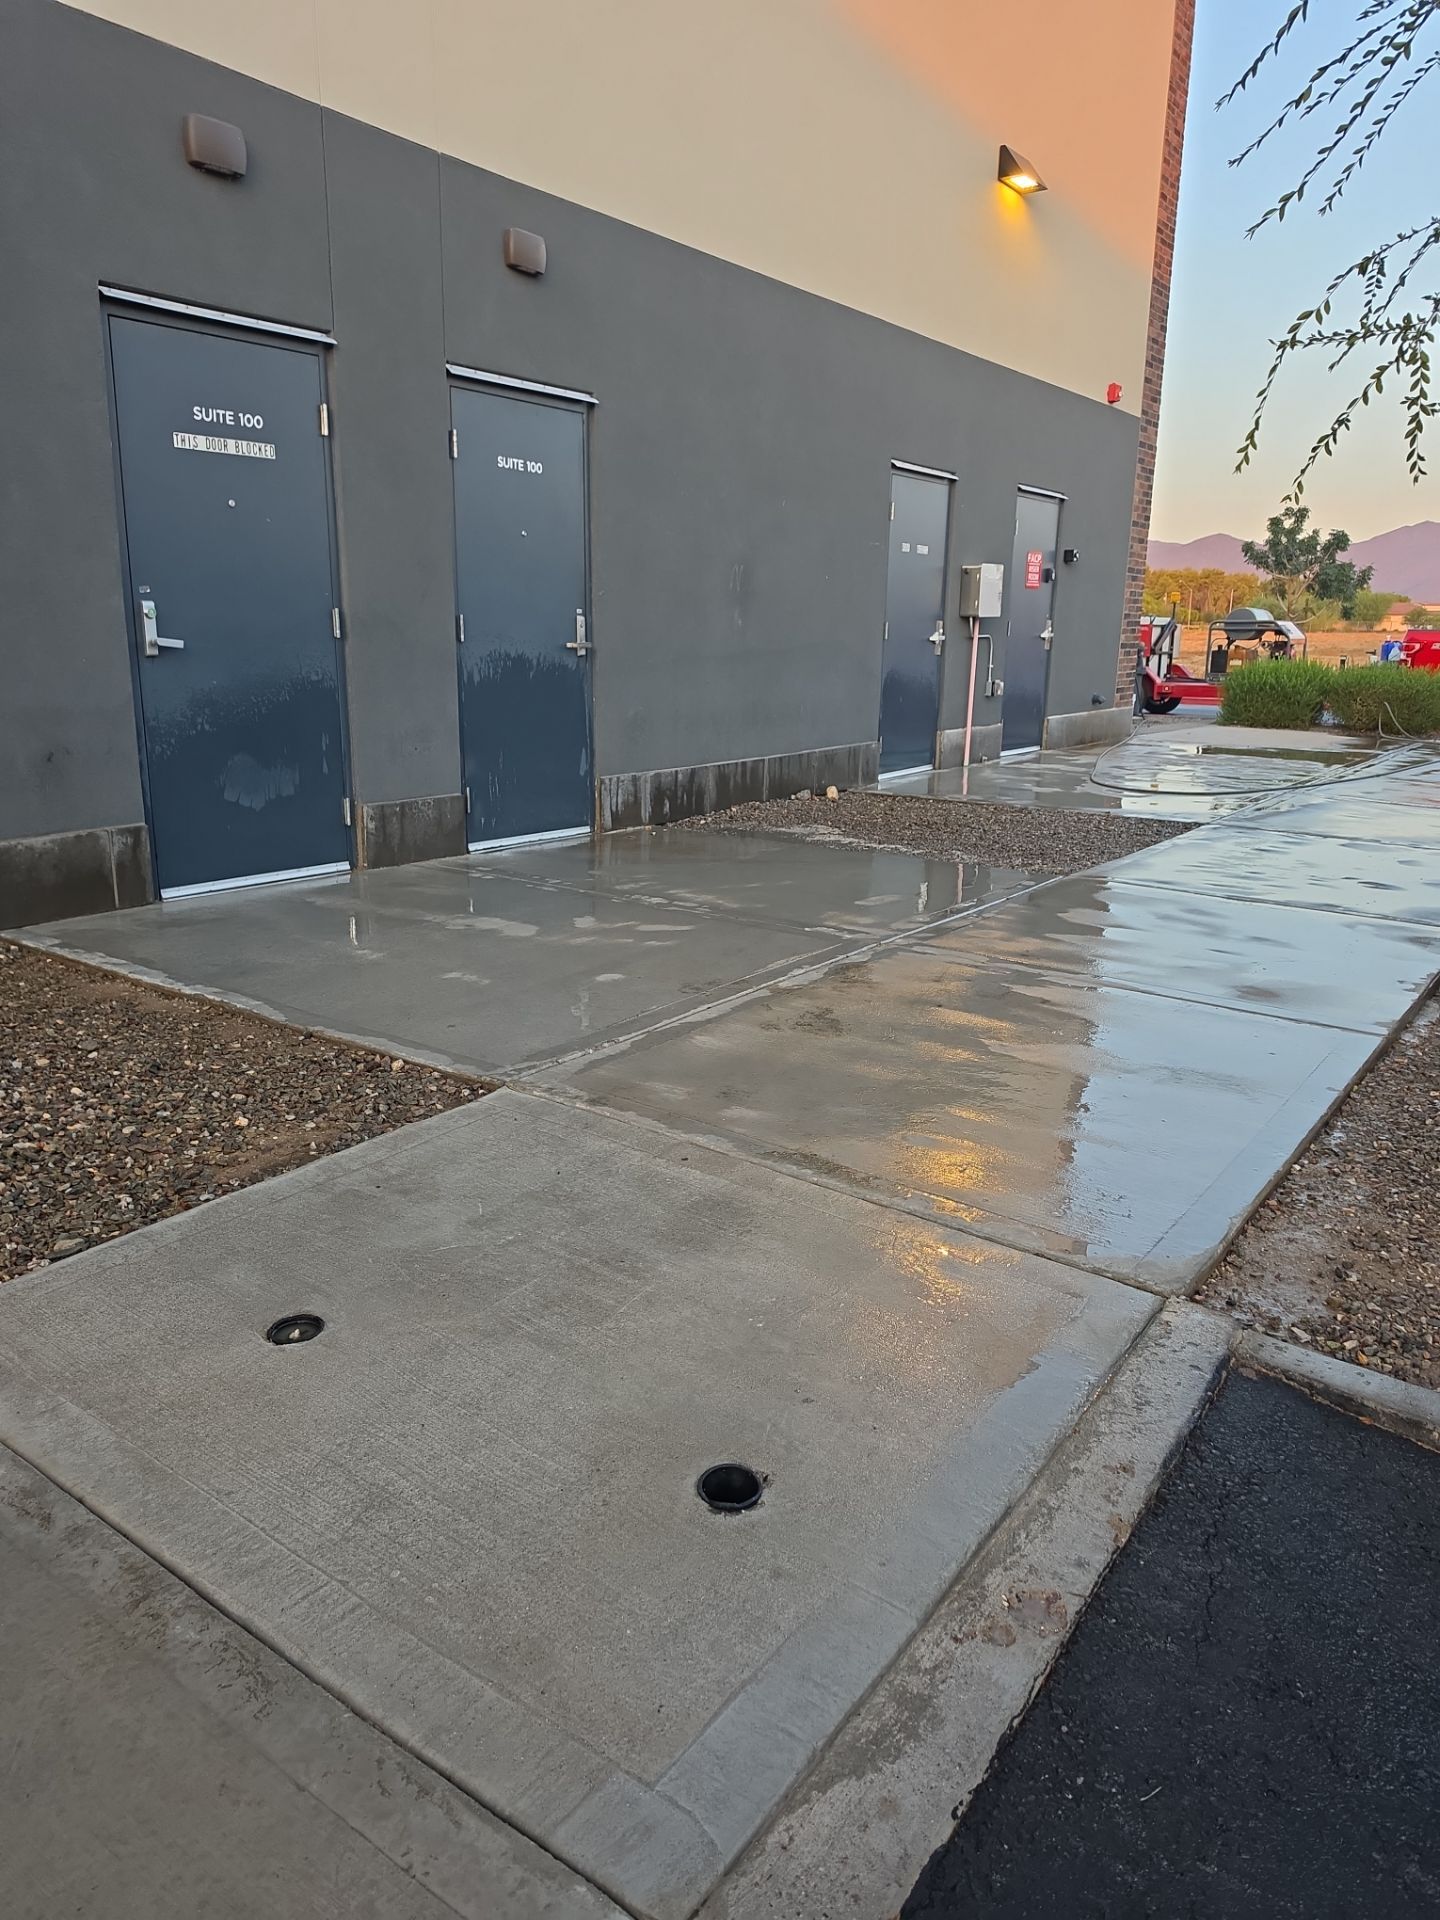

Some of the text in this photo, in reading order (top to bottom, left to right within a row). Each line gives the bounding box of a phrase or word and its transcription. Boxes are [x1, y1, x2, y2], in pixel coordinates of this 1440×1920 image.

[193, 406, 264, 429] SUITE 100
[174, 433, 275, 458] THIS DOOR BLOCKED
[497, 455, 543, 474] SUITE 100
